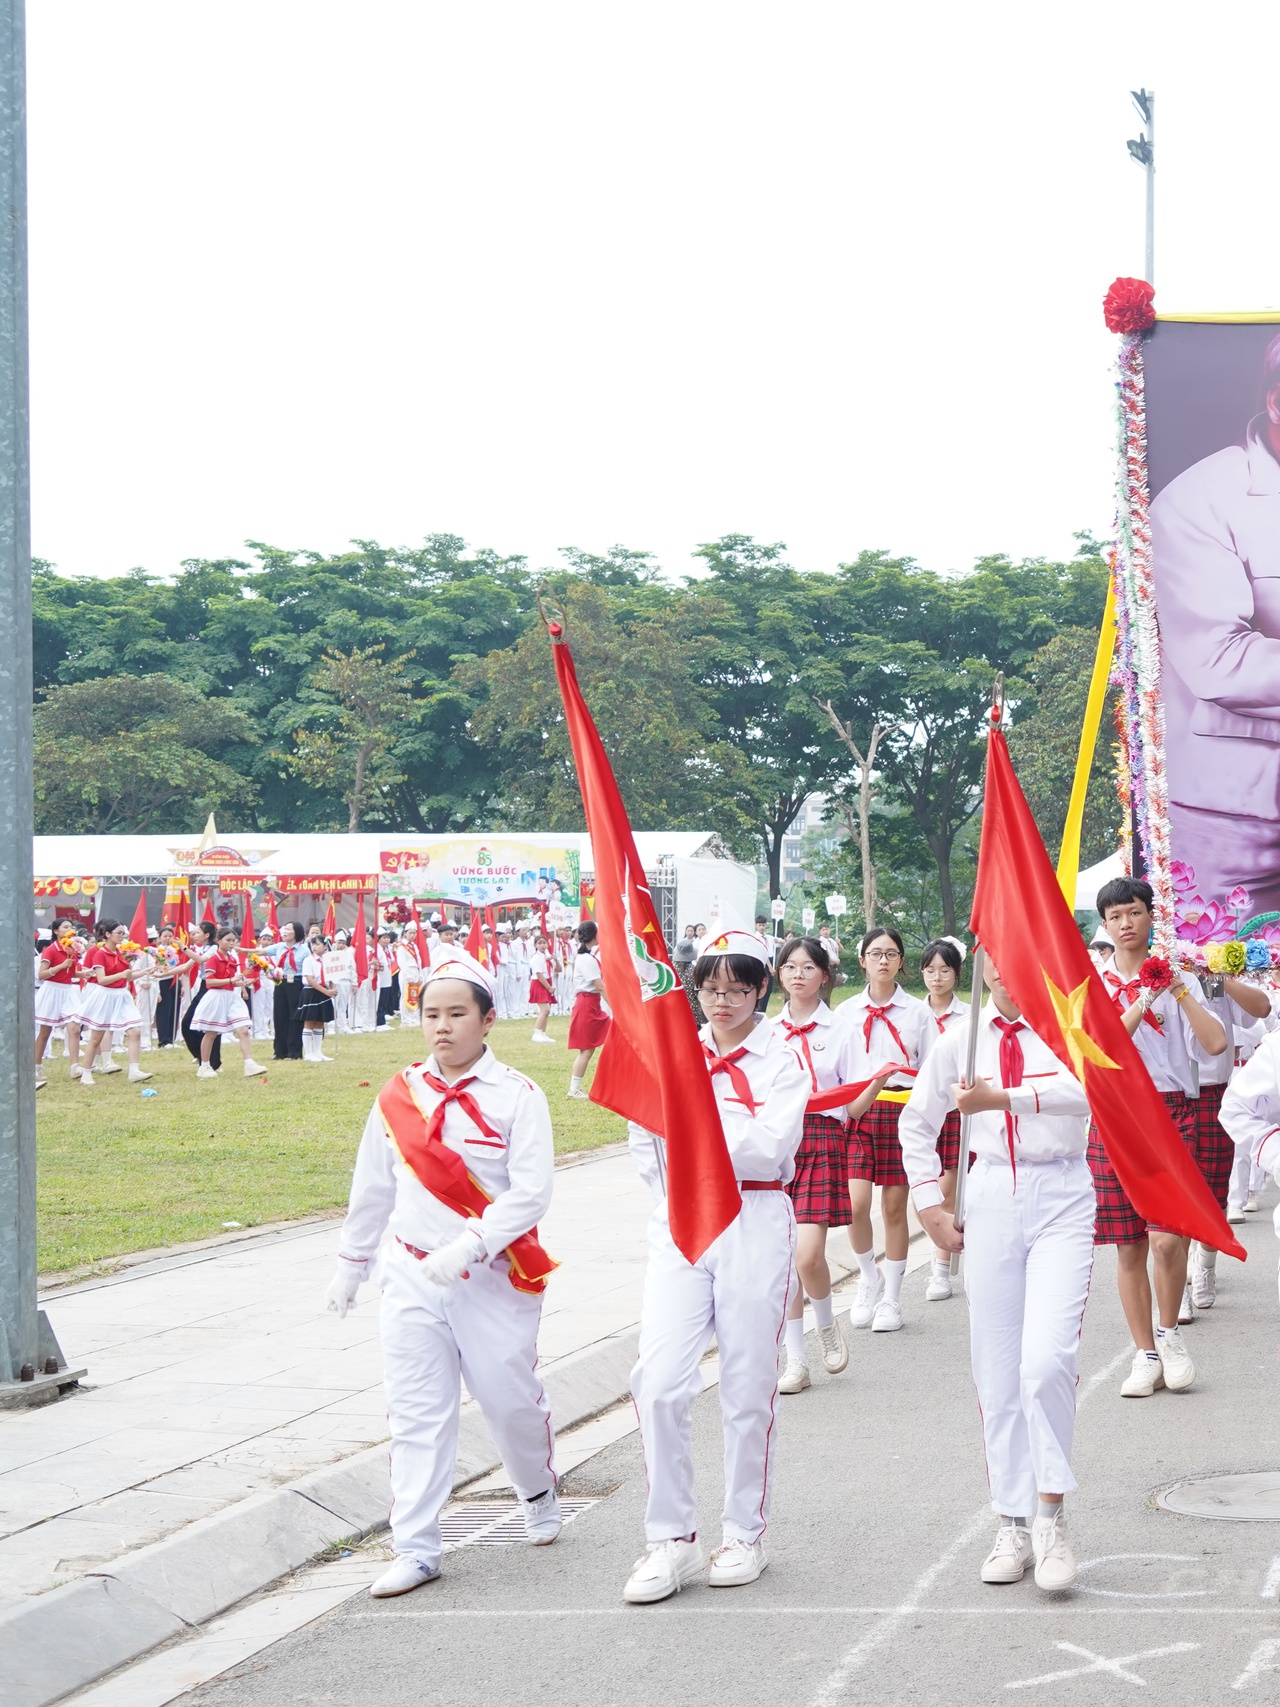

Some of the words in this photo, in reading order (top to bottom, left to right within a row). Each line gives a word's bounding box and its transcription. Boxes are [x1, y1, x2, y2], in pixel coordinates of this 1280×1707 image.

[477, 852, 492, 867] 85
[452, 865, 483, 875] VỮNG
[487, 865, 517, 875] BƯỚC
[220, 878, 237, 892] ĐỘC
[319, 879, 336, 891] VẸN
